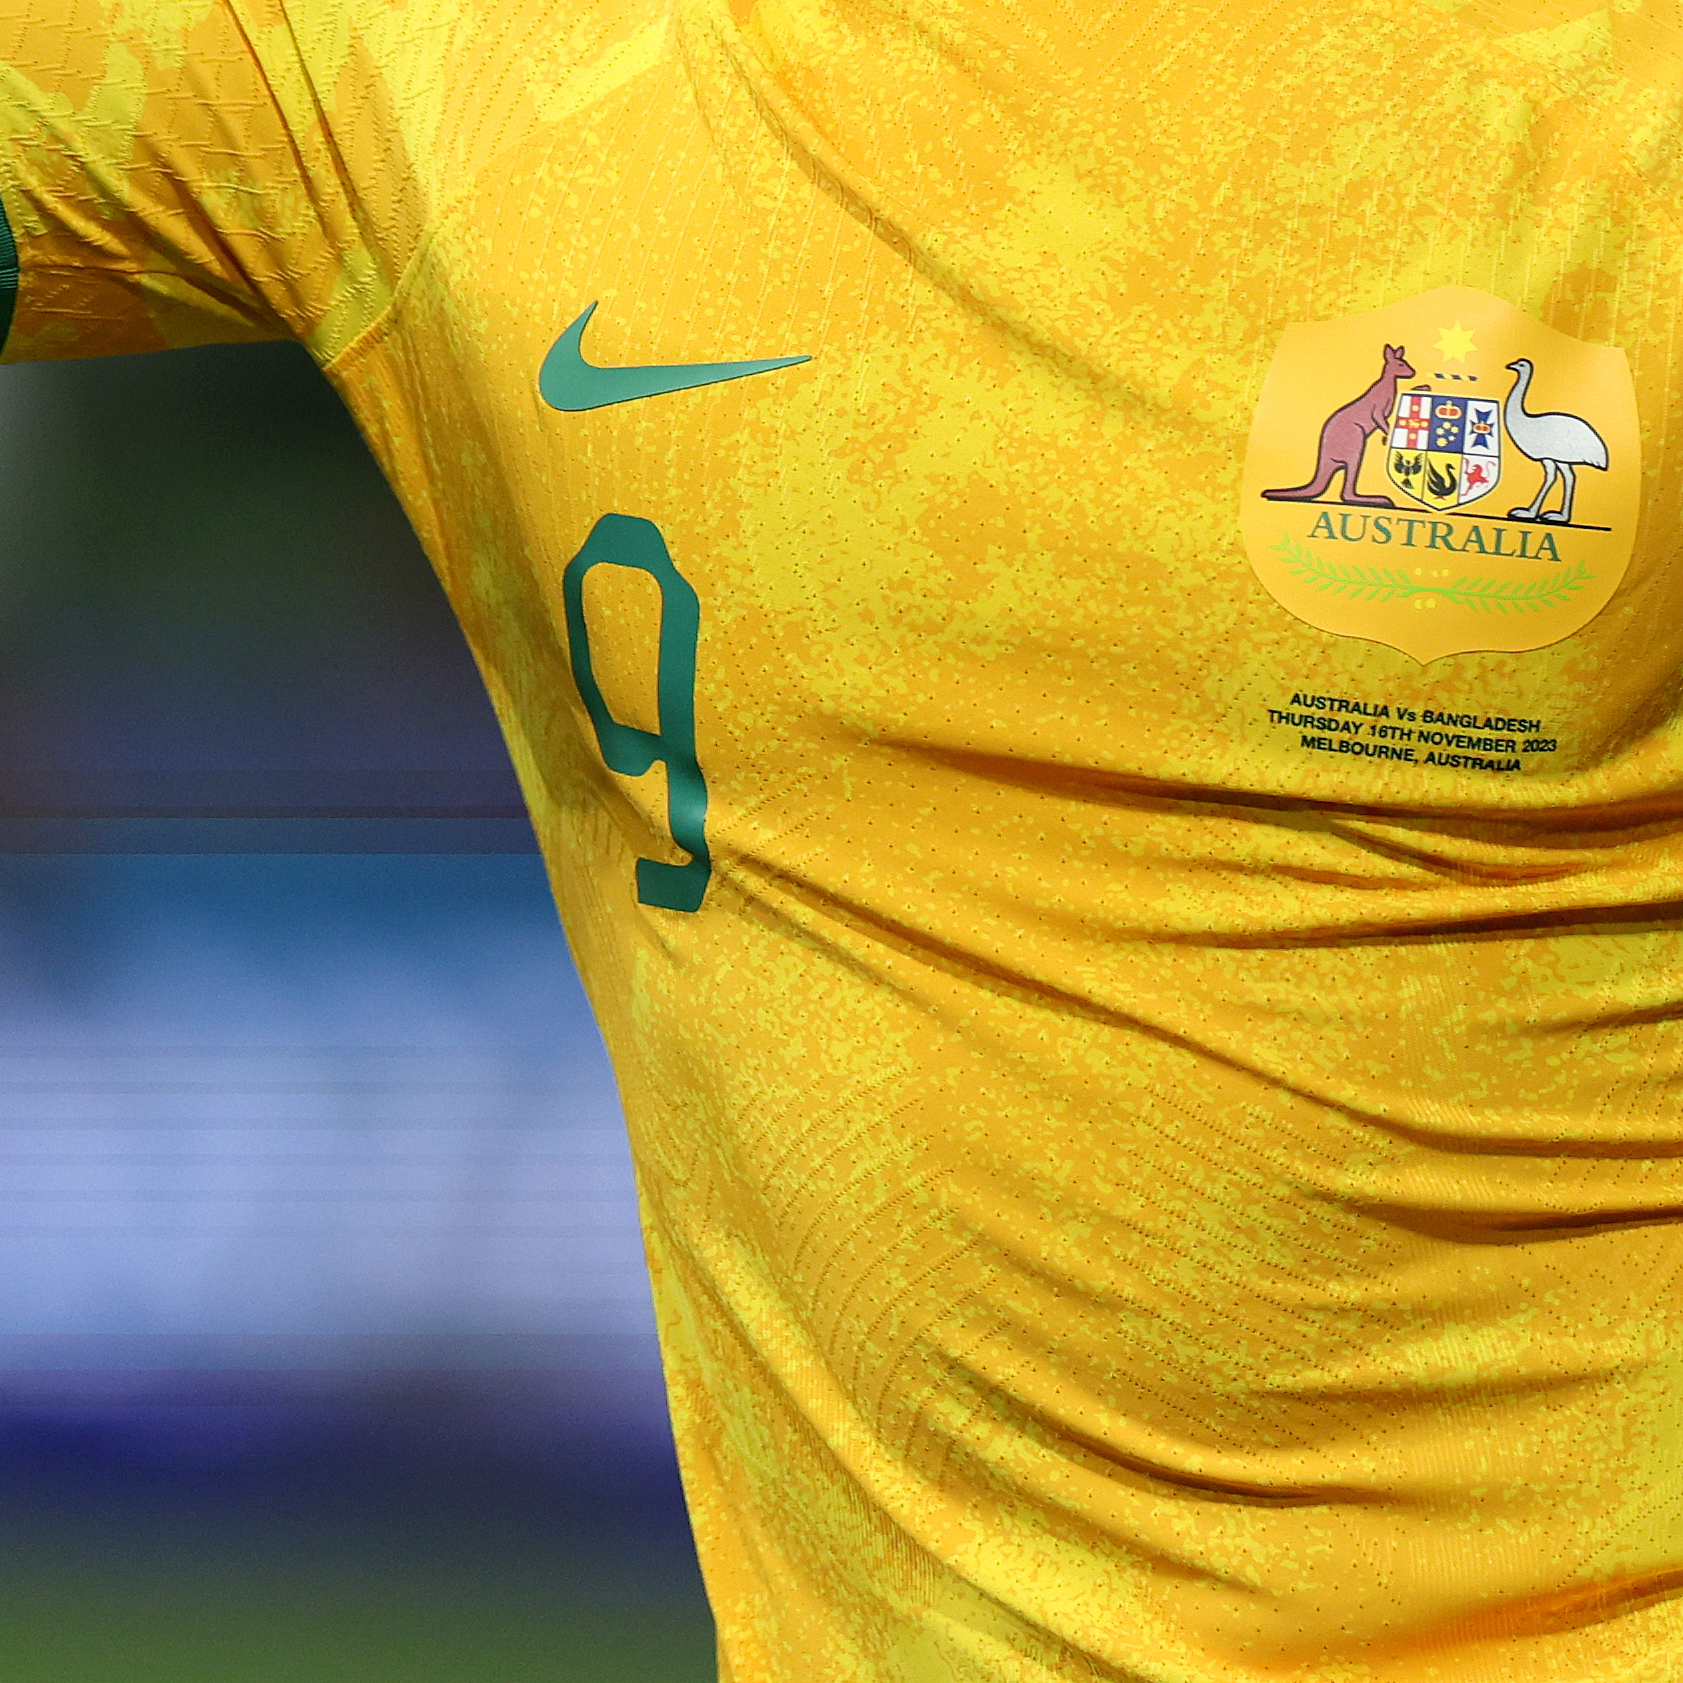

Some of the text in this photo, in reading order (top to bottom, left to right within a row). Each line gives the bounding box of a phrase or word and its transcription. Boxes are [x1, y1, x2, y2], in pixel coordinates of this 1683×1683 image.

[1307, 510, 1562, 562] AUSTRALIA
[563, 512, 711, 913] 9
[1268, 709, 1557, 754] THURSDAY 16TH NOVEMBER 2023
[1290, 692, 1541, 733] AUSTRALIA Vs BANGLADESH
[1300, 734, 1522, 772] MELBOURNE, AUSTRALIA
